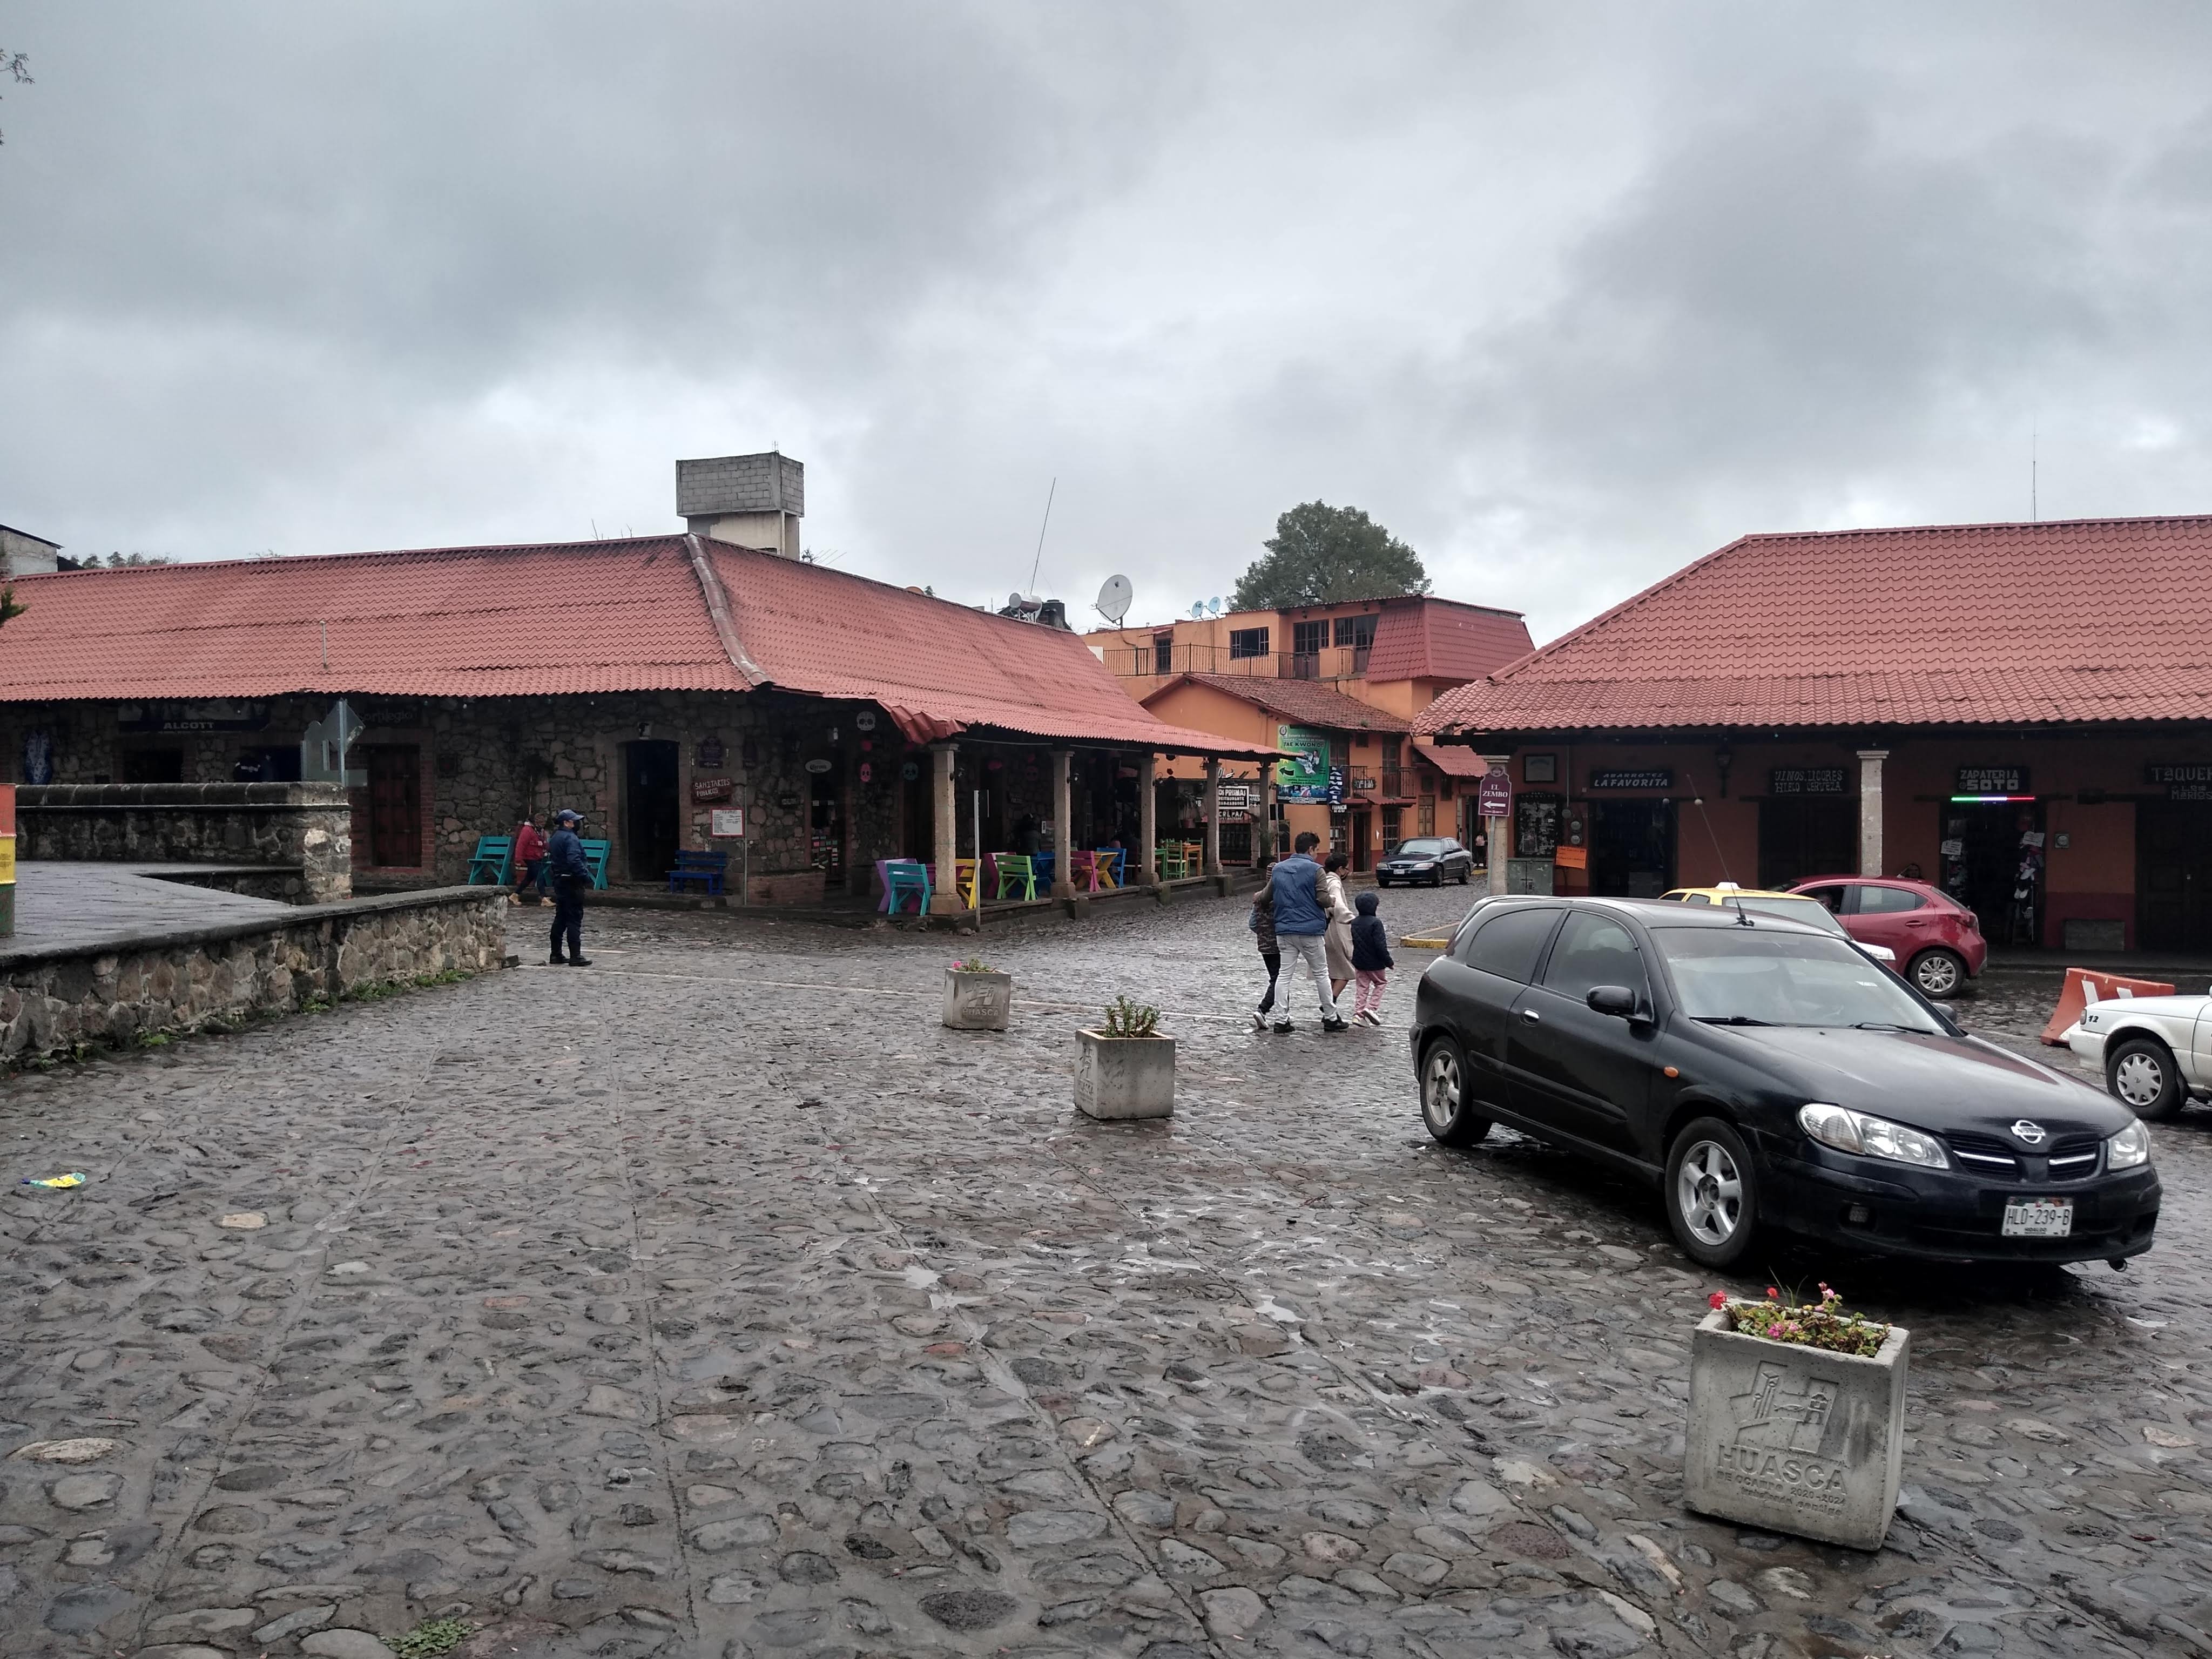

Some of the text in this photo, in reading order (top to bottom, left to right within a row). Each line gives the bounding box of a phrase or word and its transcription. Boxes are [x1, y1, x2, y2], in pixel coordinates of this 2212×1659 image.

[164, 721, 215, 730] ALCOTT
[1808, 770, 1843, 782] LICORES
[1960, 770, 2018, 779] ZAPATERIA
[694, 778, 730, 790] SANITARIOS
[1610, 779, 1668, 787] FAVORITA
[1807, 781, 1843, 792] CERVEZA
[1967, 779, 2019, 791] SOTO
[697, 788, 719, 797] PUBLICOS
[962, 1007, 1000, 1016] HUASCA
[2006, 1208, 2071, 1226] HLD-239-B
[1717, 1444, 1848, 1496] HUASCA
[1717, 1470, 1732, 1482] DE
